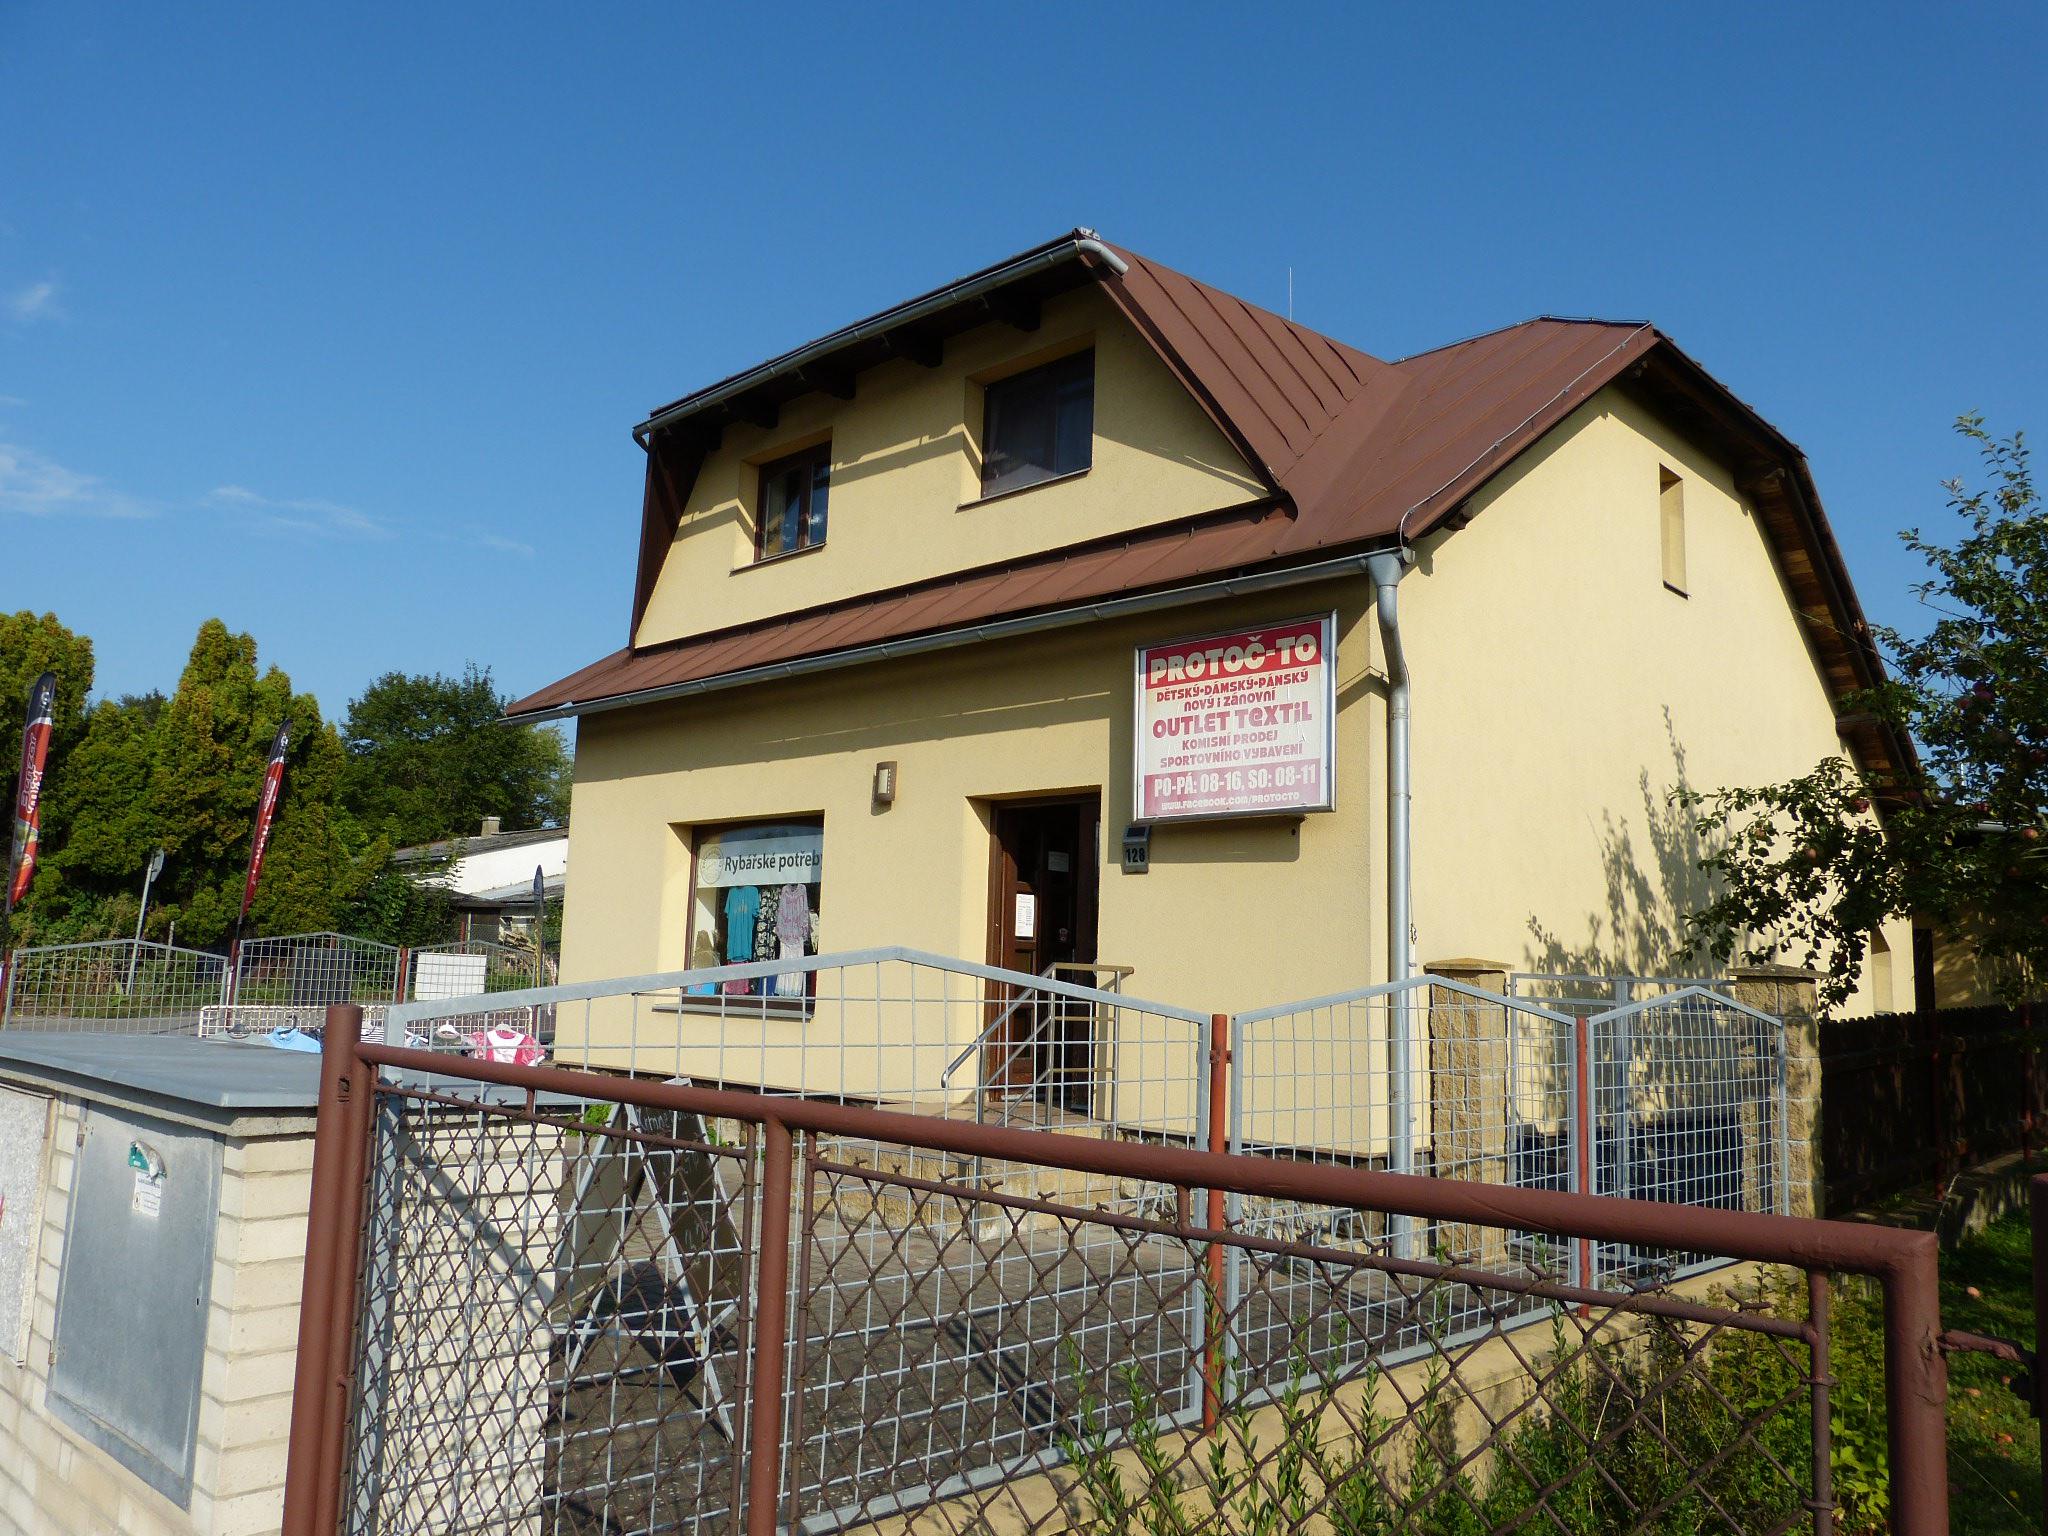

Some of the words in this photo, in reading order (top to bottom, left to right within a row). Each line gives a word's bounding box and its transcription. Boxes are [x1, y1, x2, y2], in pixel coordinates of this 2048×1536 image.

[1150, 634, 1317, 685] PROTOČ-TO
[1152, 711, 1231, 739] OUTLET
[1182, 732, 1230, 750] KOMISNÍ
[1160, 749, 1240, 768] SPORTOVNÍHO
[1154, 770, 1197, 797] PO-PÁ:
[1200, 771, 1244, 793] 08-16,
[1248, 768, 1272, 788] SO:
[1275, 764, 1316, 787] 08-11
[725, 852, 776, 875] Rybářské
[779, 849, 822, 872] potřeb
[1126, 847, 1146, 863] 128
